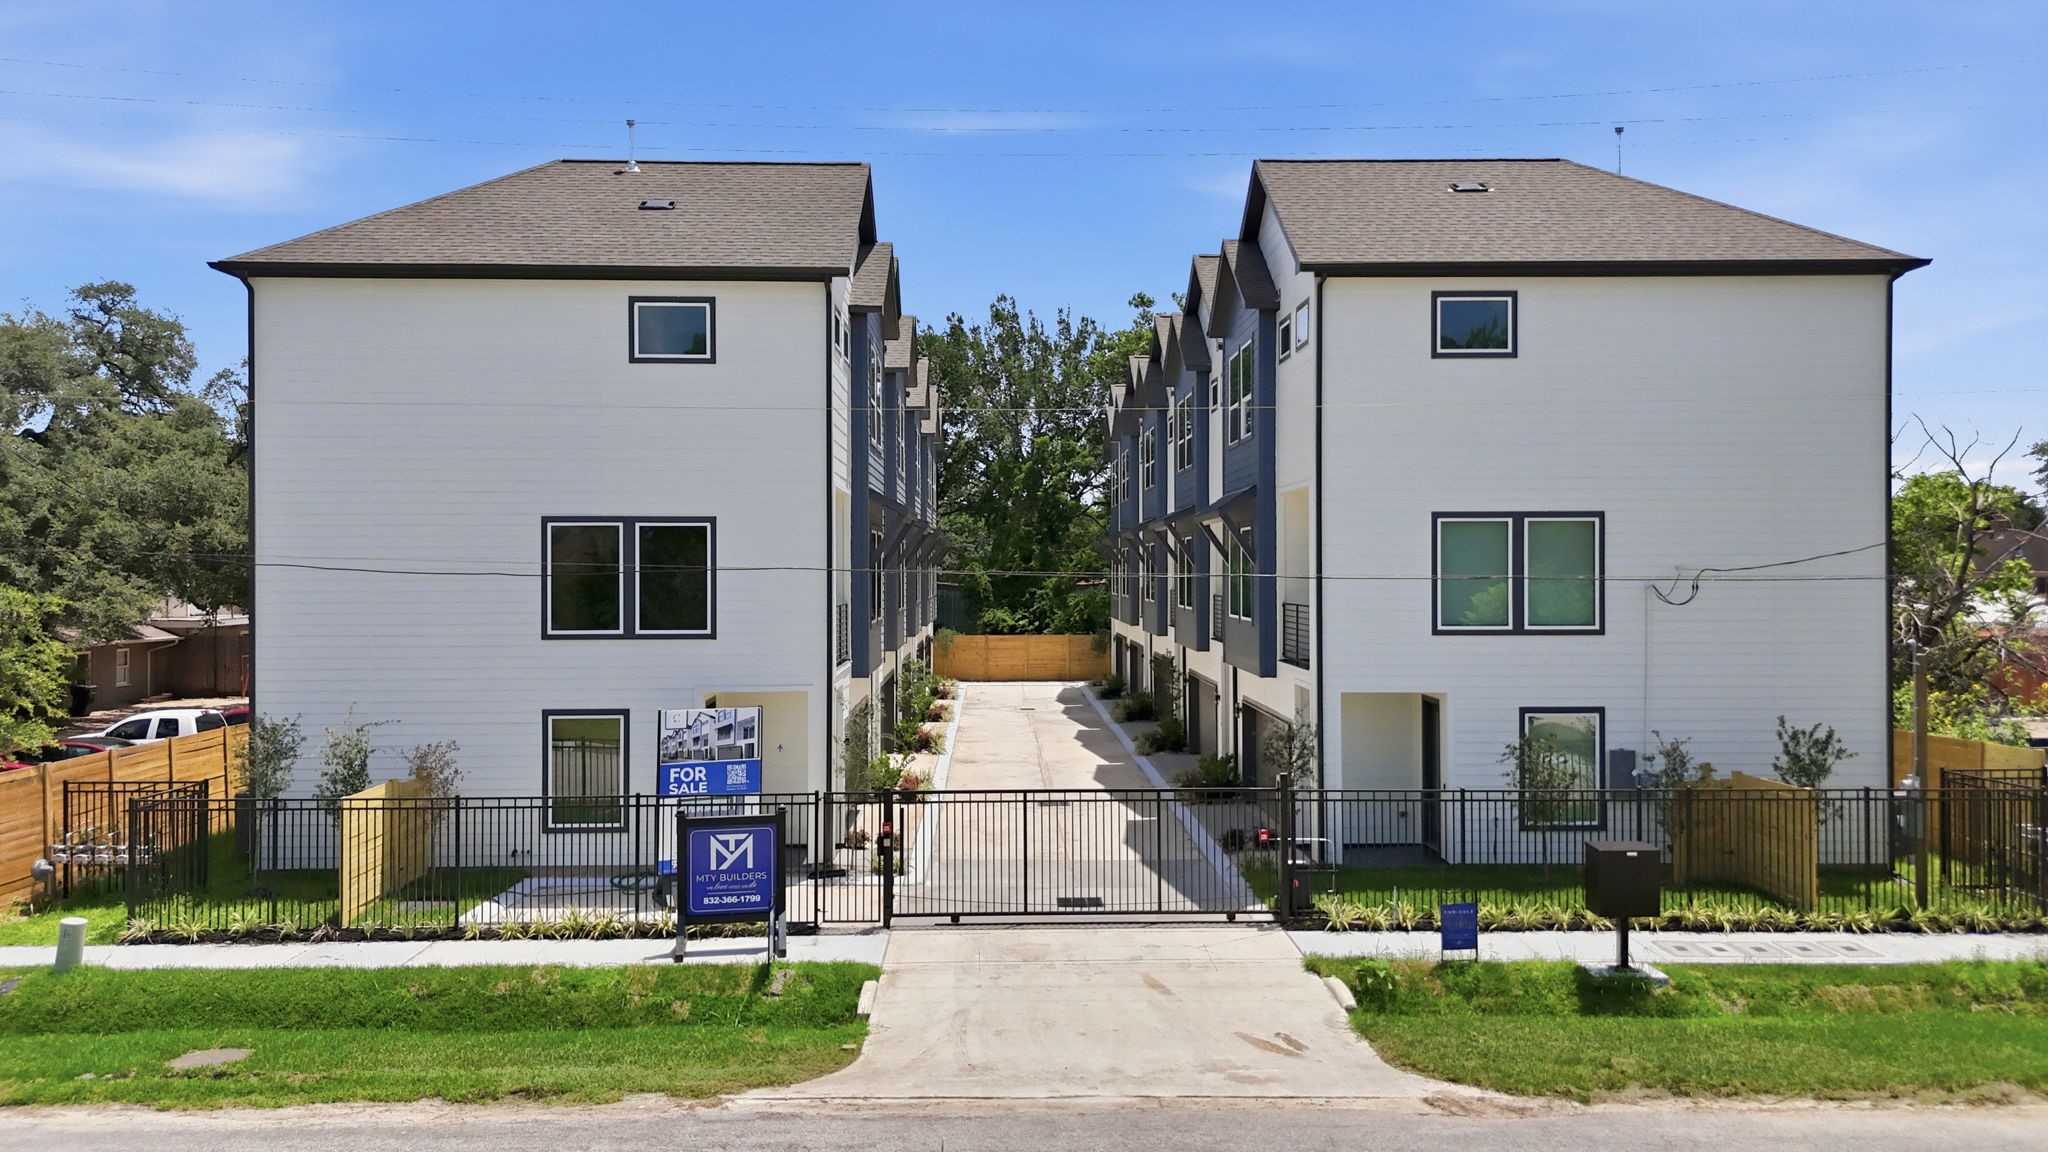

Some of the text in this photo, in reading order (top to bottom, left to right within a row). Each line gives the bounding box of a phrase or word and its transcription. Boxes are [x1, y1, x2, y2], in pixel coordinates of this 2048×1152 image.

[670, 767, 707, 782] FOR
[669, 782, 708, 795] SALE
[720, 872, 767, 882] BUILDERS
[703, 895, 761, 905] 832-366-1799
